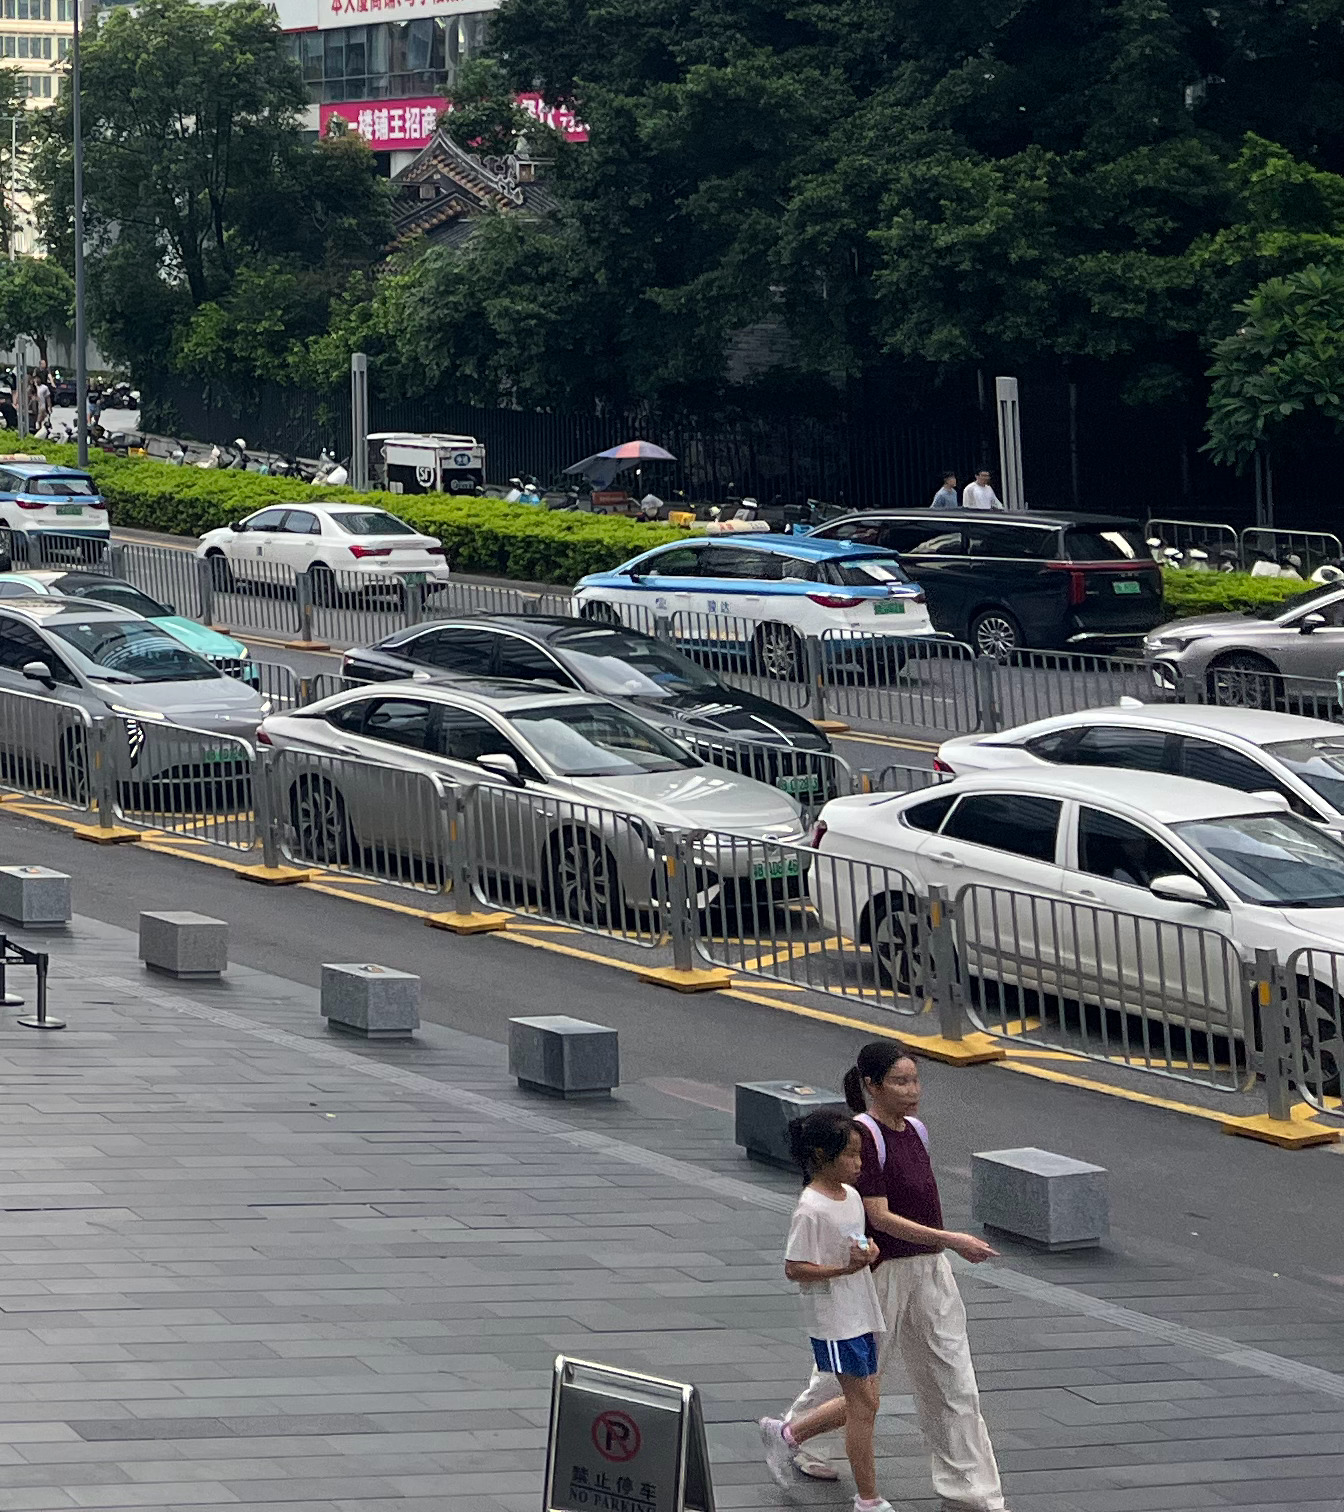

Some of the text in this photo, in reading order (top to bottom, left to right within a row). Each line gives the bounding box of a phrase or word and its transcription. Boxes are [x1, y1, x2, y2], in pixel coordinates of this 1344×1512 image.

[332, 105, 438, 141] 一楼铺王招商
[568, 1488, 588, 1504] NO
